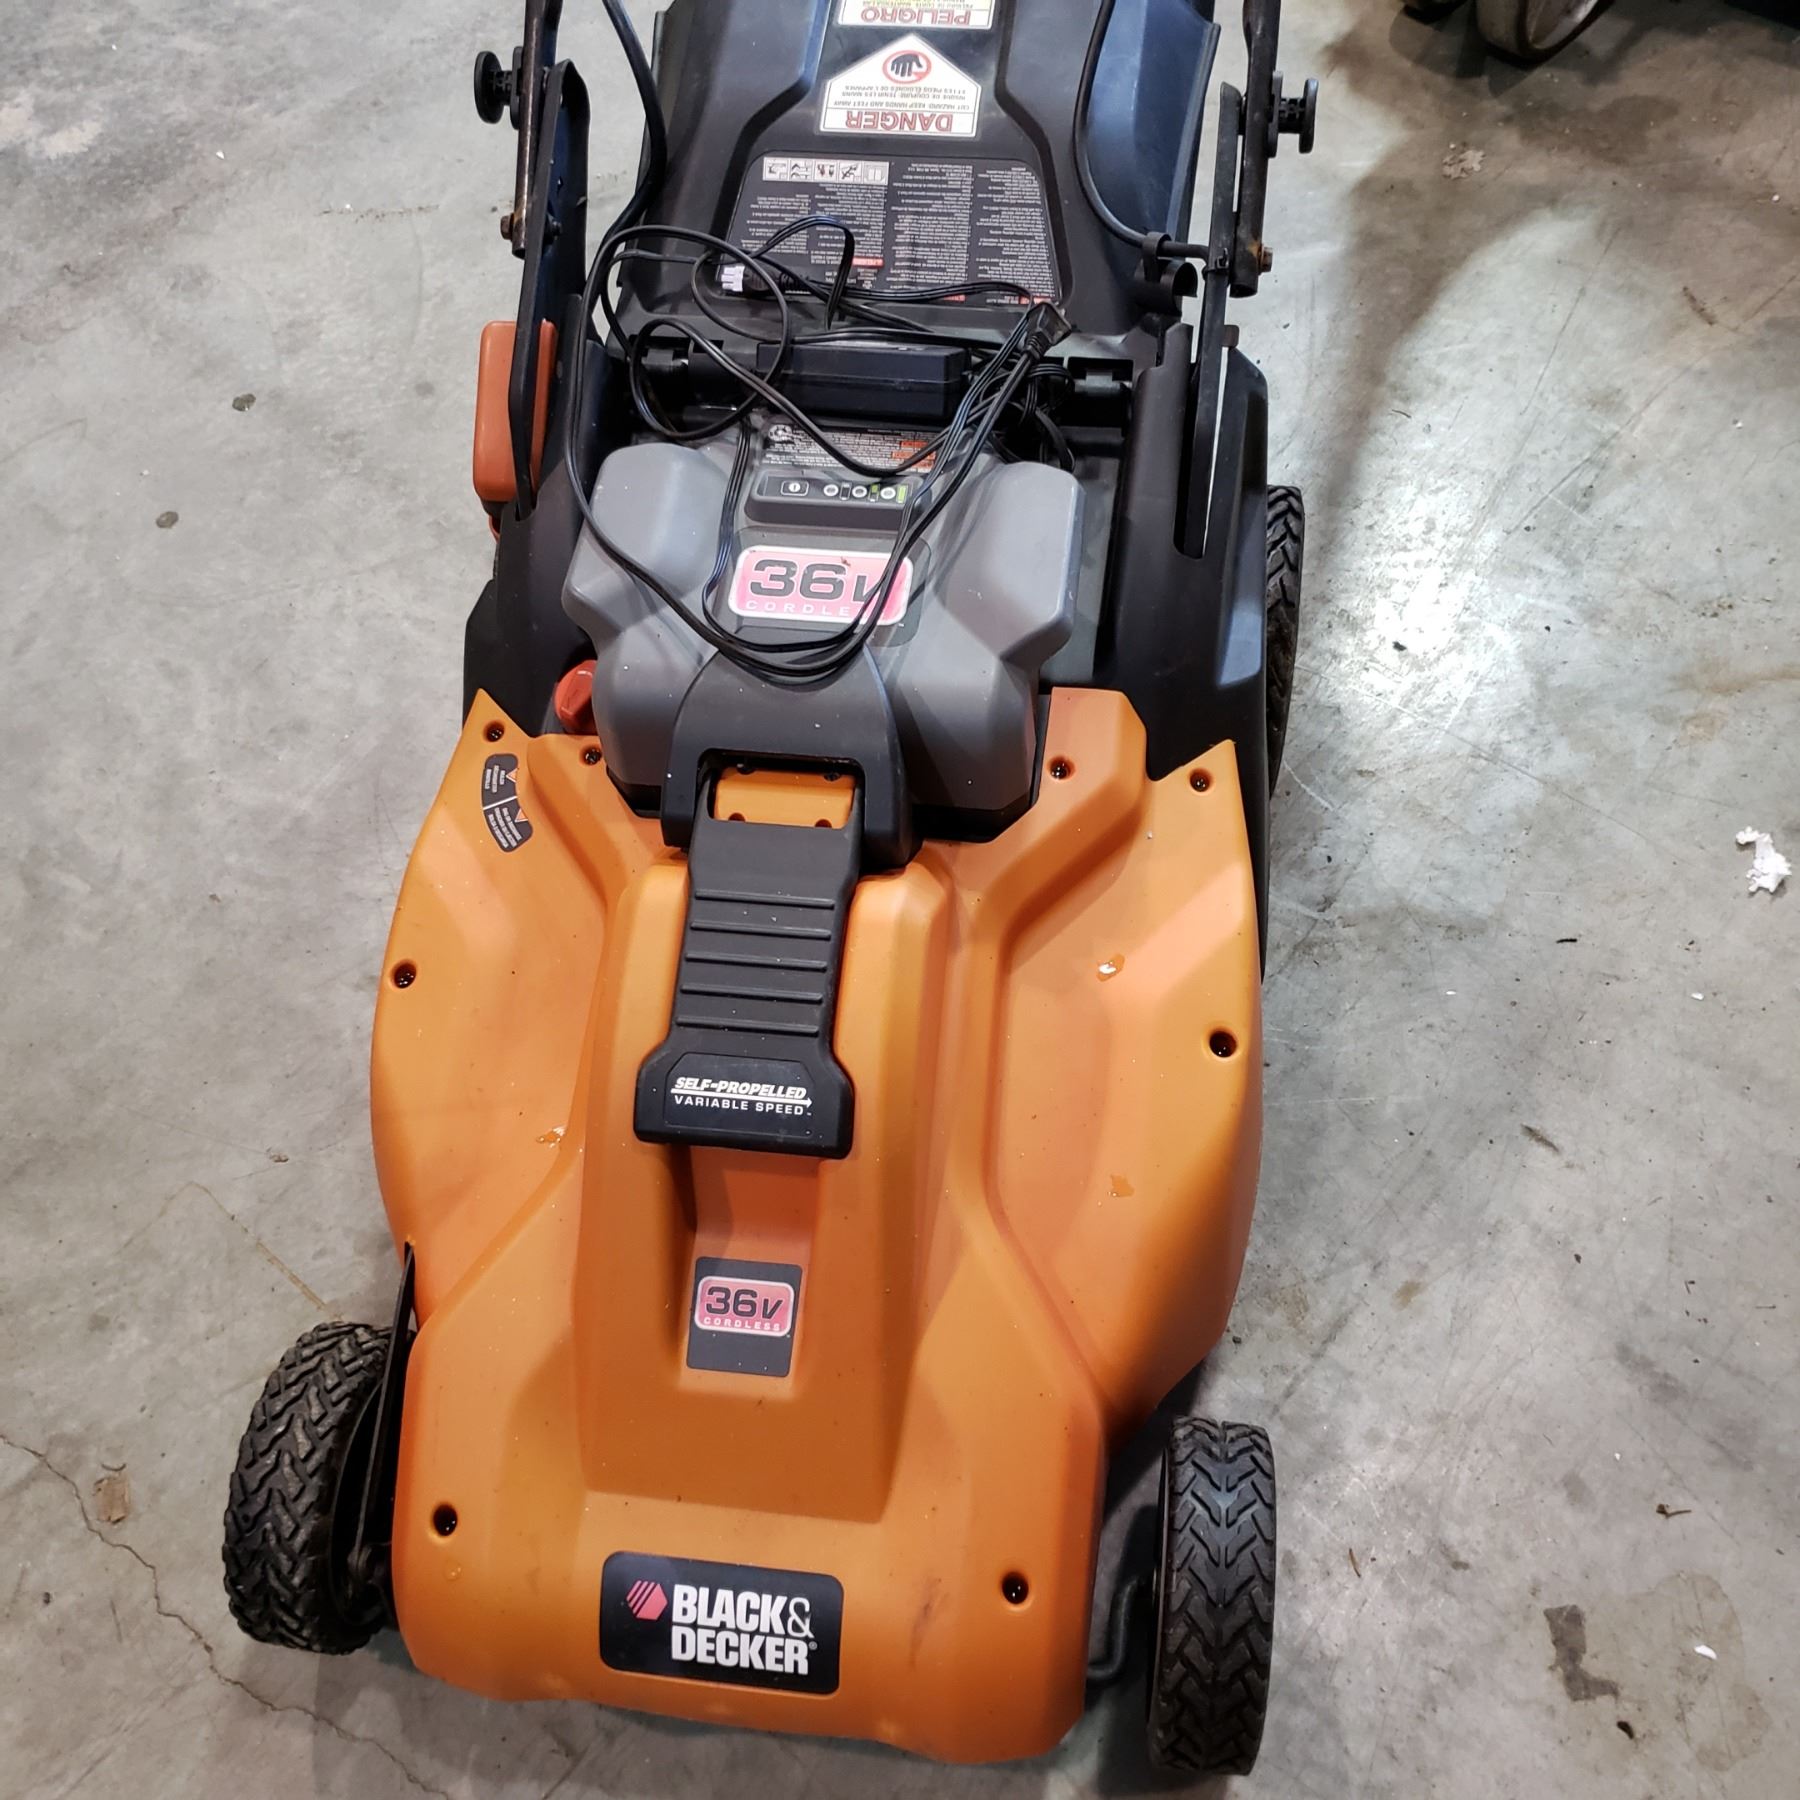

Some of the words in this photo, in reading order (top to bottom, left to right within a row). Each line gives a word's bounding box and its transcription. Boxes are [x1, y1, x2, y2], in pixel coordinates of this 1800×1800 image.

[860, 7, 972, 26] PELIGRO
[869, 100, 884, 108] AND
[885, 101, 908, 109] HANDS
[845, 111, 954, 133] DANGER
[674, 1077, 807, 1099] SELF-PROPELLED
[674, 1095, 749, 1111] VARIABLE
[755, 1102, 804, 1116] SPEED
[703, 1316, 781, 1331] CORDLESS
